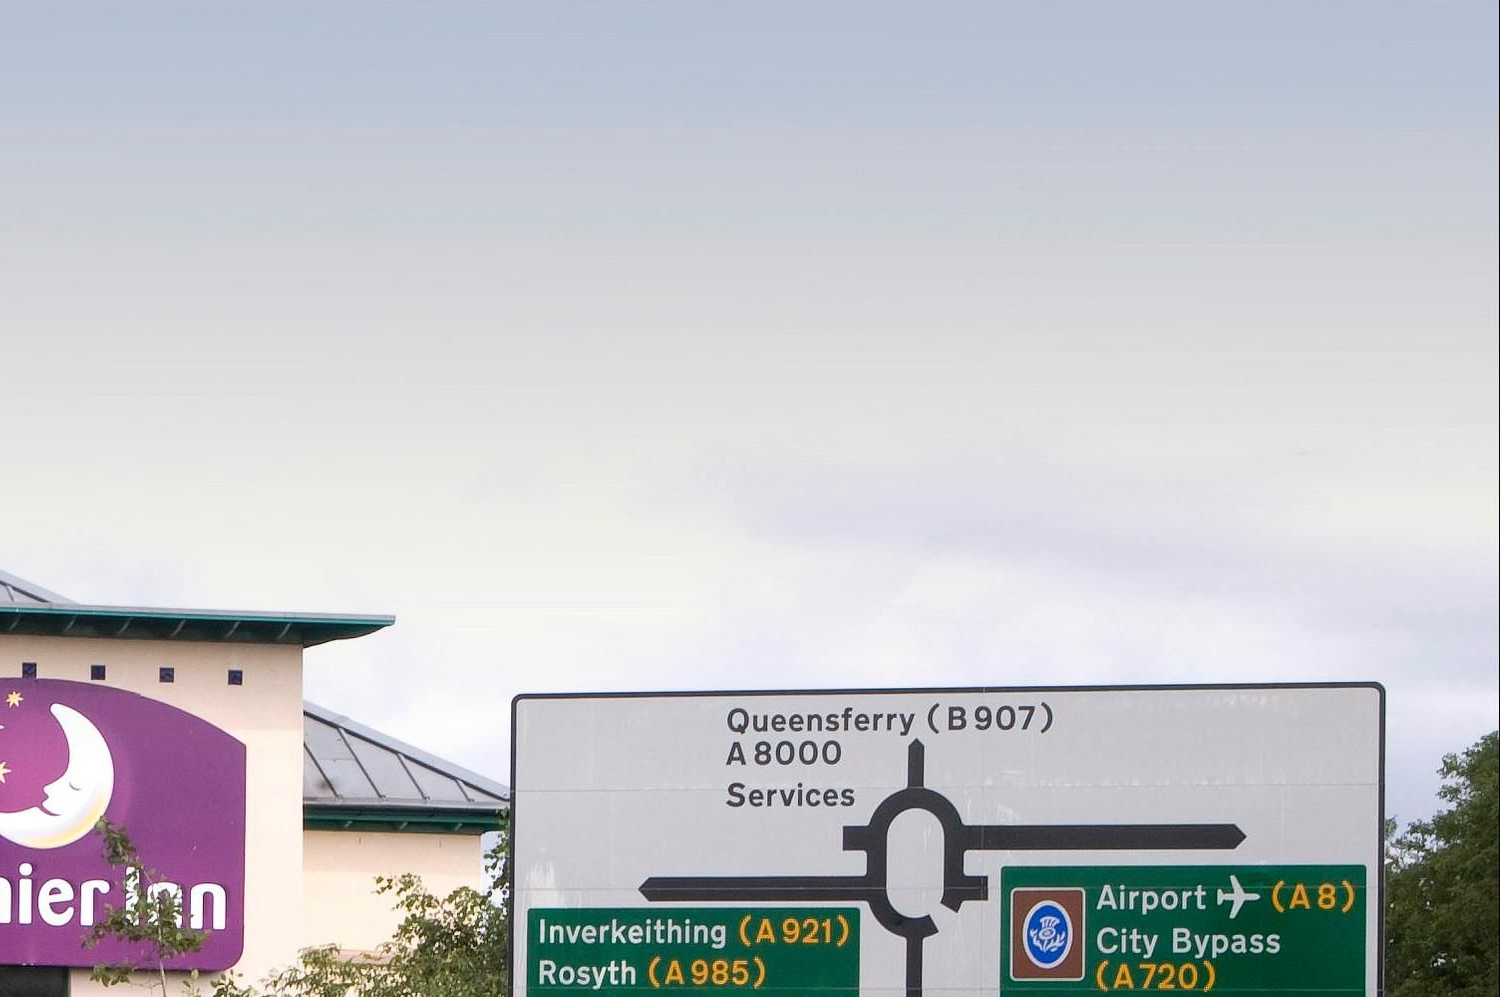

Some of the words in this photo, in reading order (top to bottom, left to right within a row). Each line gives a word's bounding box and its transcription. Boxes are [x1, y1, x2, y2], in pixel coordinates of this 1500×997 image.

[726, 707, 915, 737] Queensferry
[726, 782, 855, 808] Services
[1097, 884, 1206, 914] Airport
[539, 919, 726, 949] Inverkeithing
[1097, 927, 1158, 959] City
[1172, 927, 1280, 959] Bypass
[539, 959, 636, 990] Rosyth
